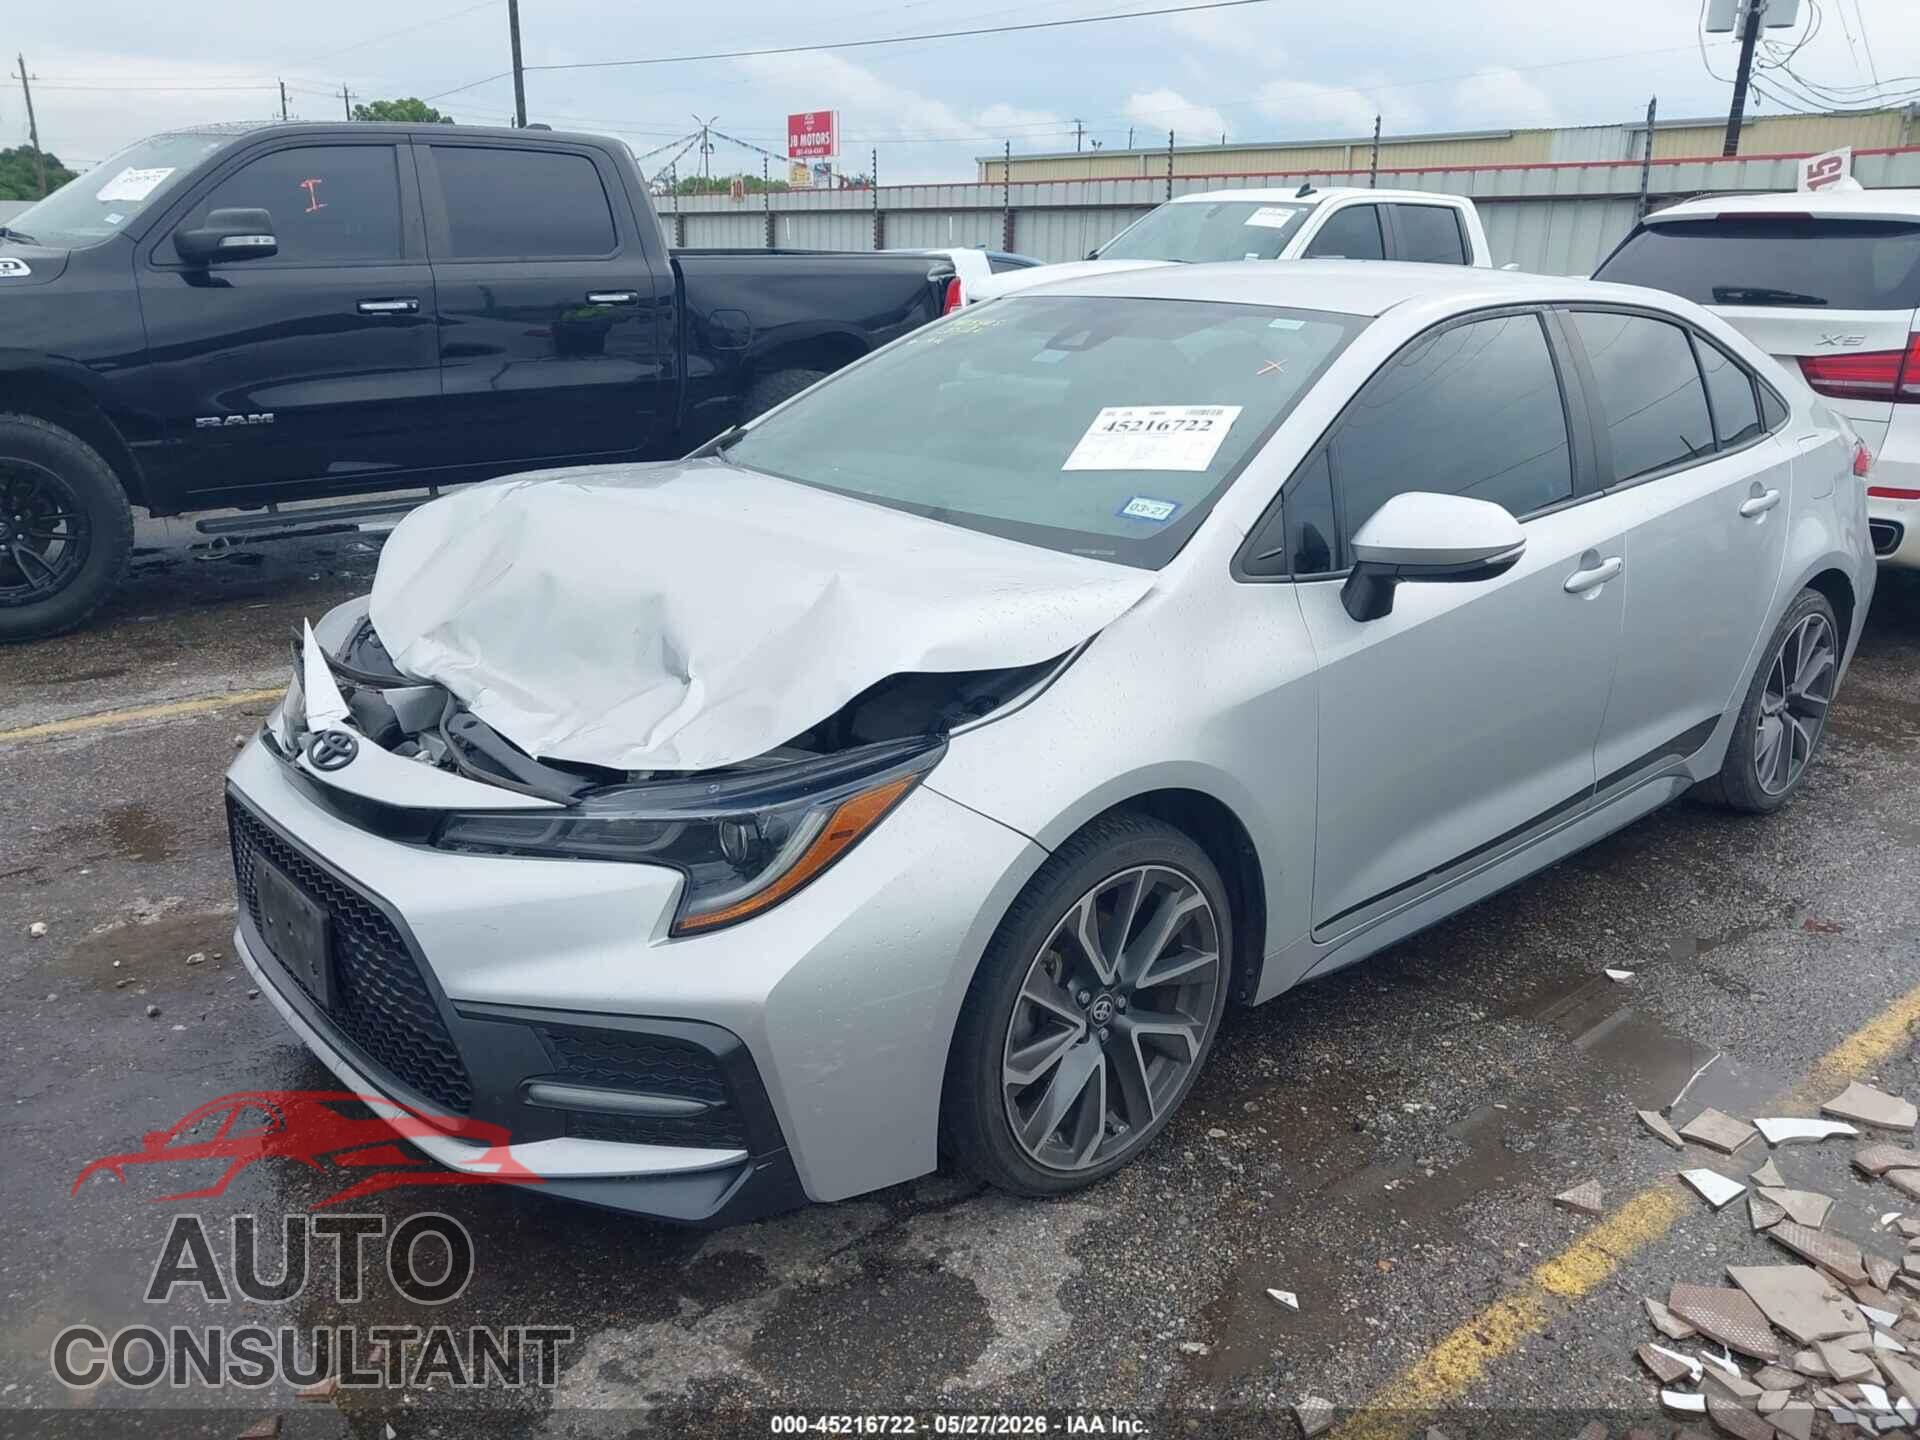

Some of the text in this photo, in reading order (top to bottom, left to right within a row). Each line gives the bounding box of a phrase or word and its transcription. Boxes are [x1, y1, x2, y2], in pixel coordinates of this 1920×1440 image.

[800, 131, 831, 147] MOTORS
[1807, 156, 1843, 192] 15
[1815, 334, 1866, 347] X5
[195, 413, 275, 428] RAM
[1102, 419, 1214, 433] 45216722
